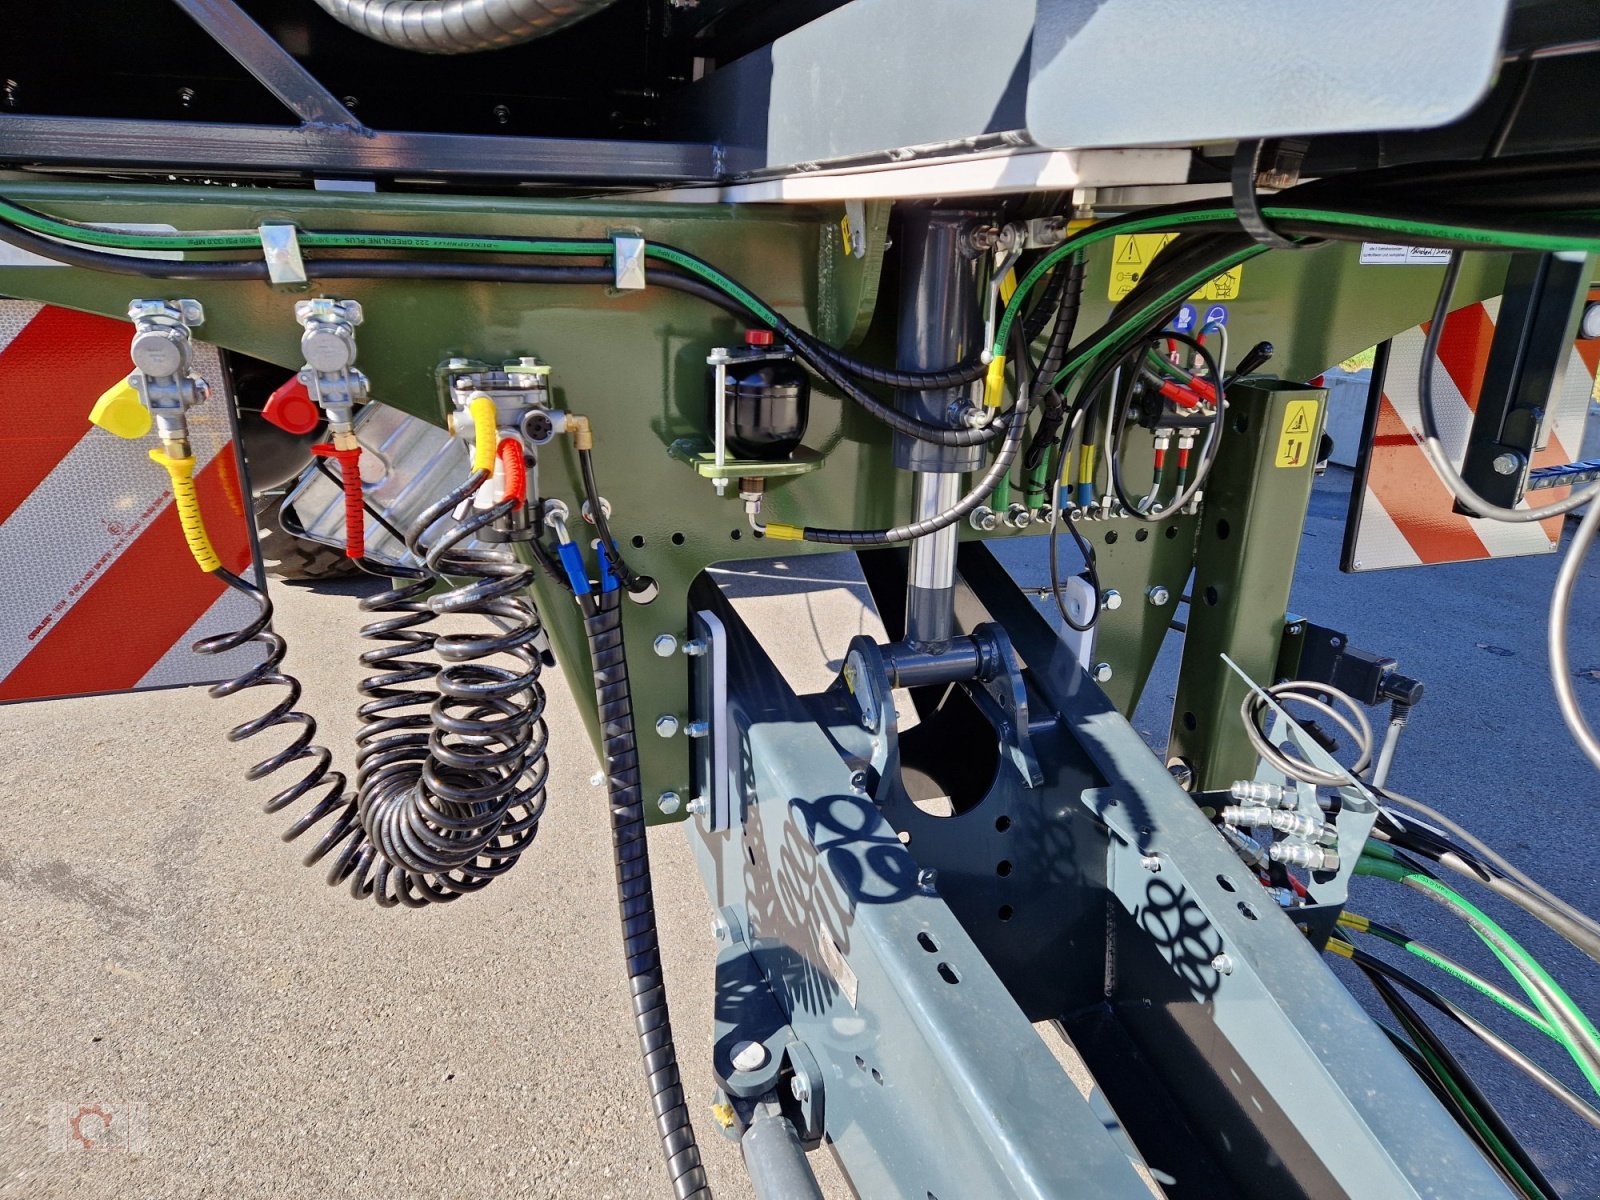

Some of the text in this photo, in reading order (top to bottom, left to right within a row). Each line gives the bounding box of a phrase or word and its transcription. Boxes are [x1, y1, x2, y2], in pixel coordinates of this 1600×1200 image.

[367, 237, 413, 246] GREENLINE
[1422, 953, 1441, 967] PLUS
[1443, 966, 1484, 992] GREENLINE
